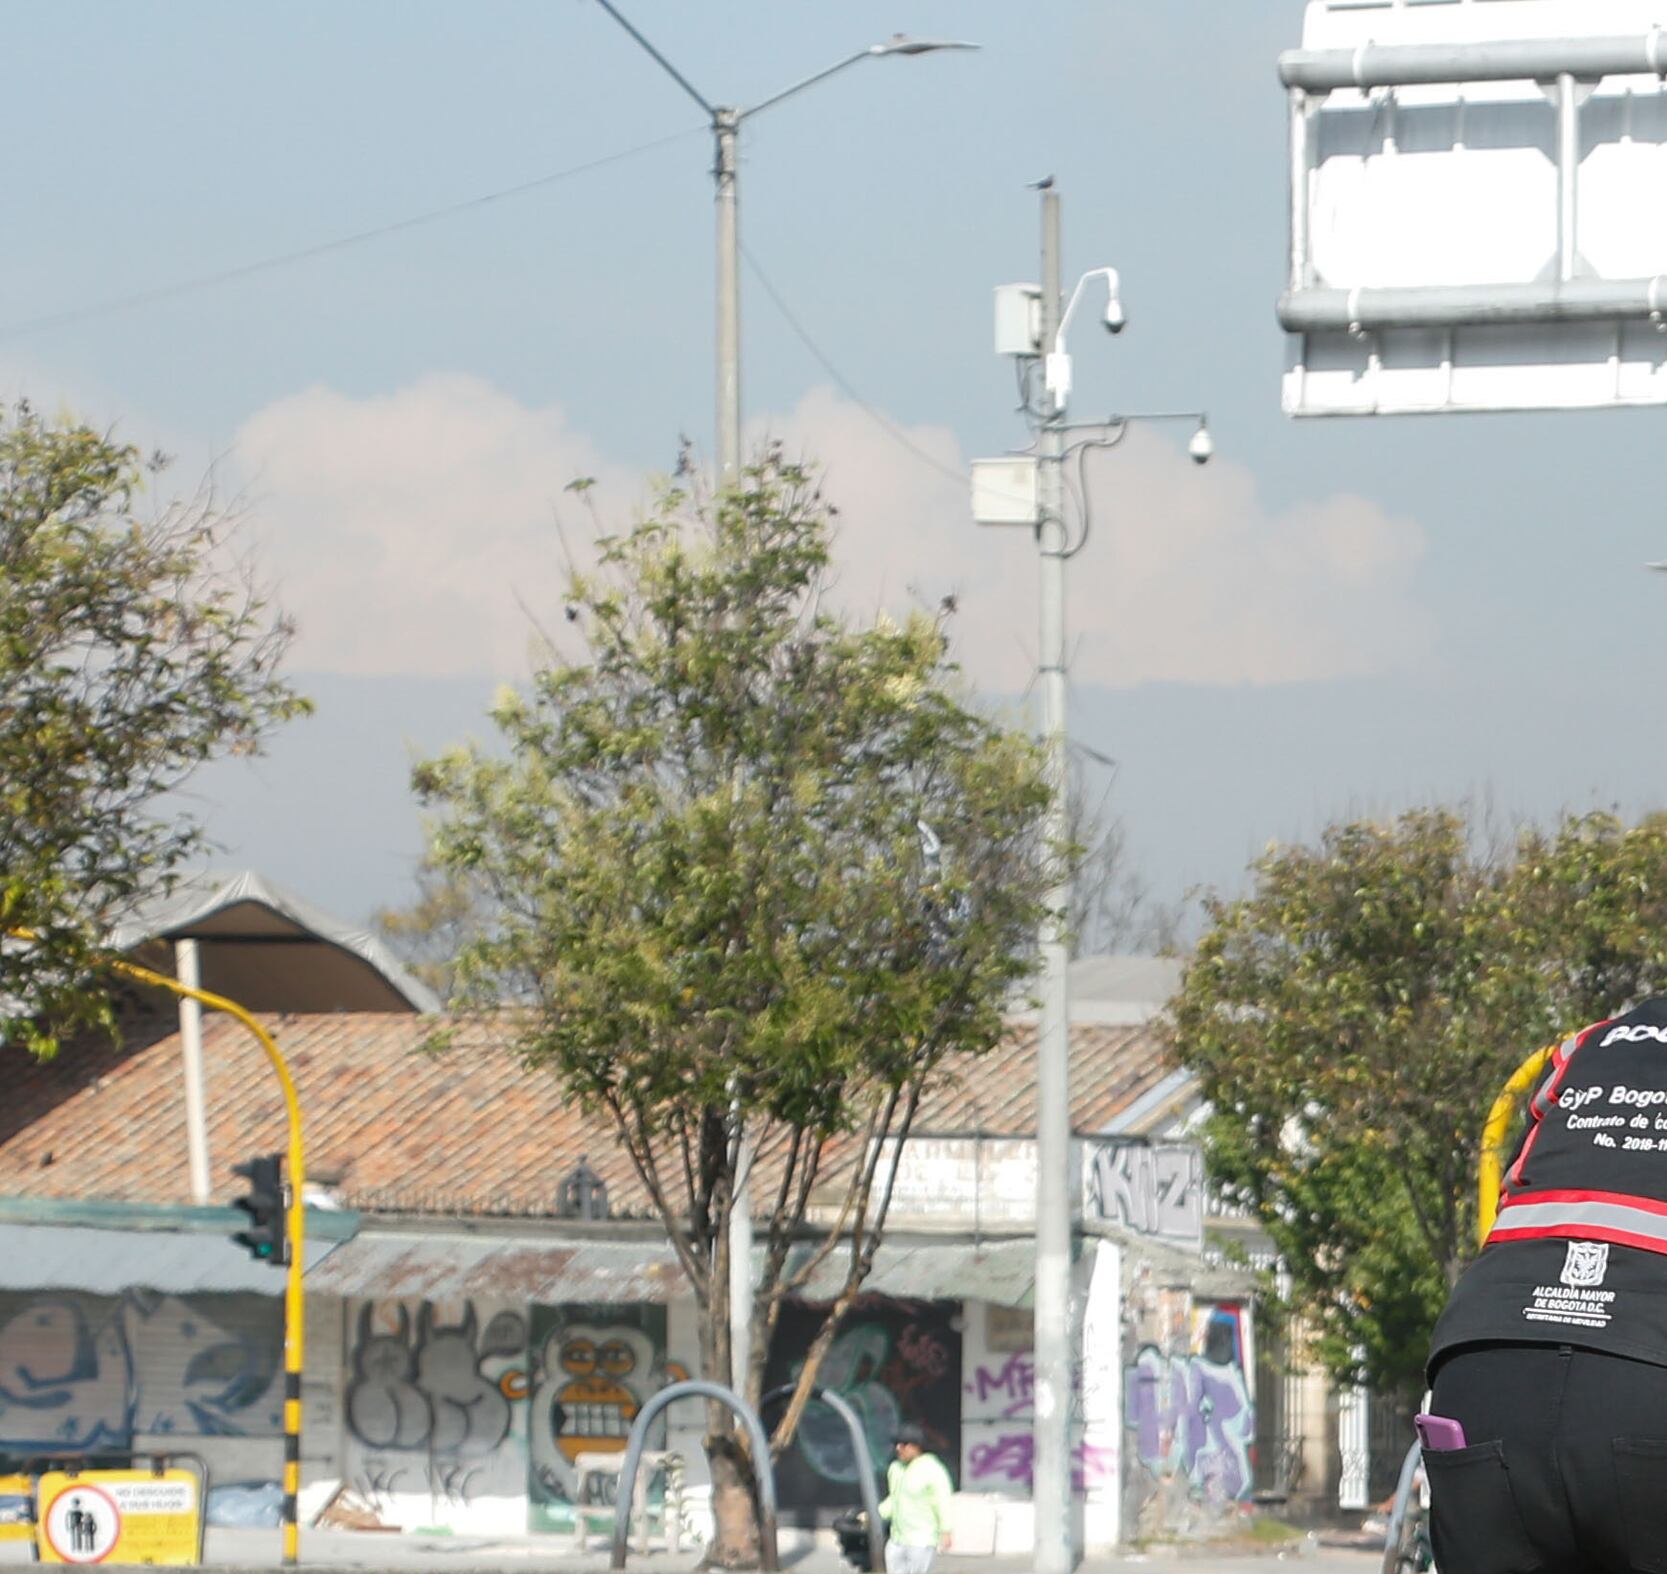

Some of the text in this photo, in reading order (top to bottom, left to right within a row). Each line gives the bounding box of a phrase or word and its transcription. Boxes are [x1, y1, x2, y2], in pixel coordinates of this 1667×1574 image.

[1566, 1114, 1626, 1130] Contrato
[1629, 1113, 1649, 1129] de
[1593, 1132, 1617, 1148] No.
[1580, 1288, 1616, 1302] MAYOR
[1534, 1298, 1548, 1309] DE
[1586, 1302, 1605, 1314] D.C.
